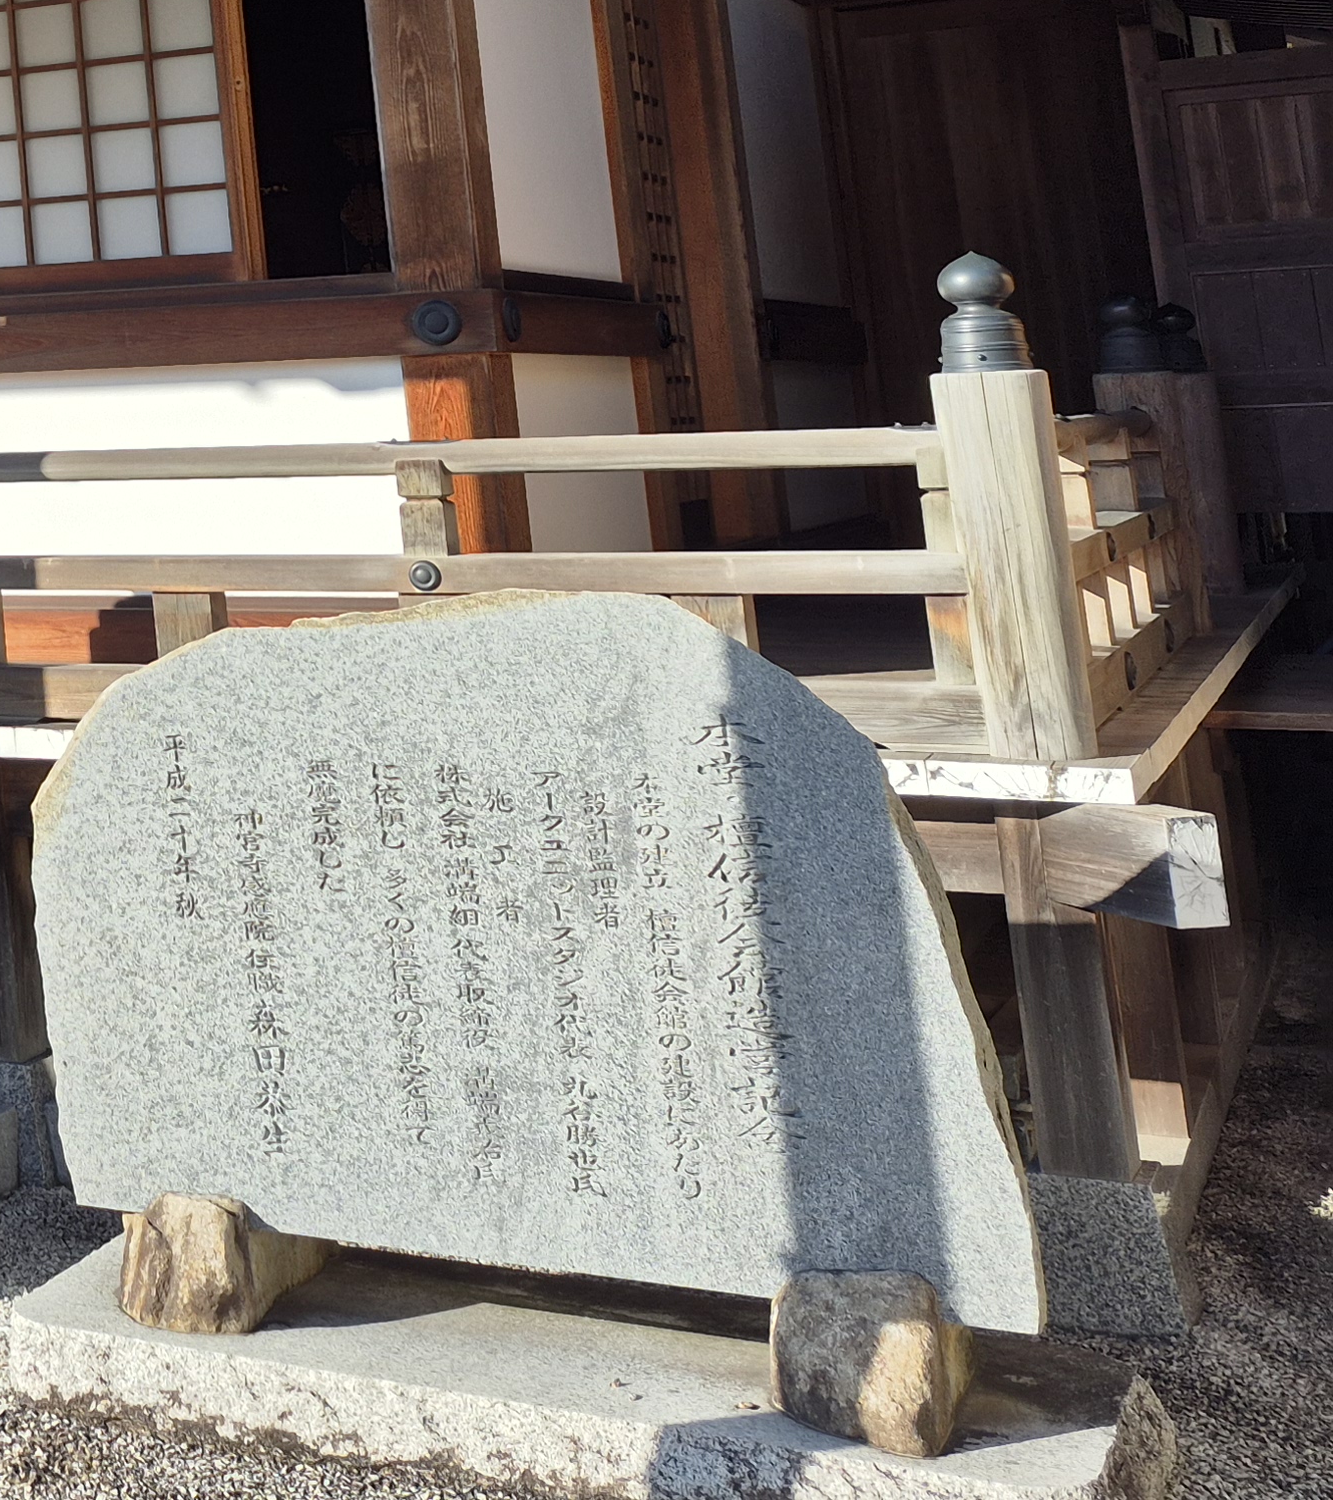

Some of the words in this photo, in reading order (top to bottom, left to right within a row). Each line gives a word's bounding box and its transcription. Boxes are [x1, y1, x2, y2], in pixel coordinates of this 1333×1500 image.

[580, 791, 621, 929] 設計監理者
